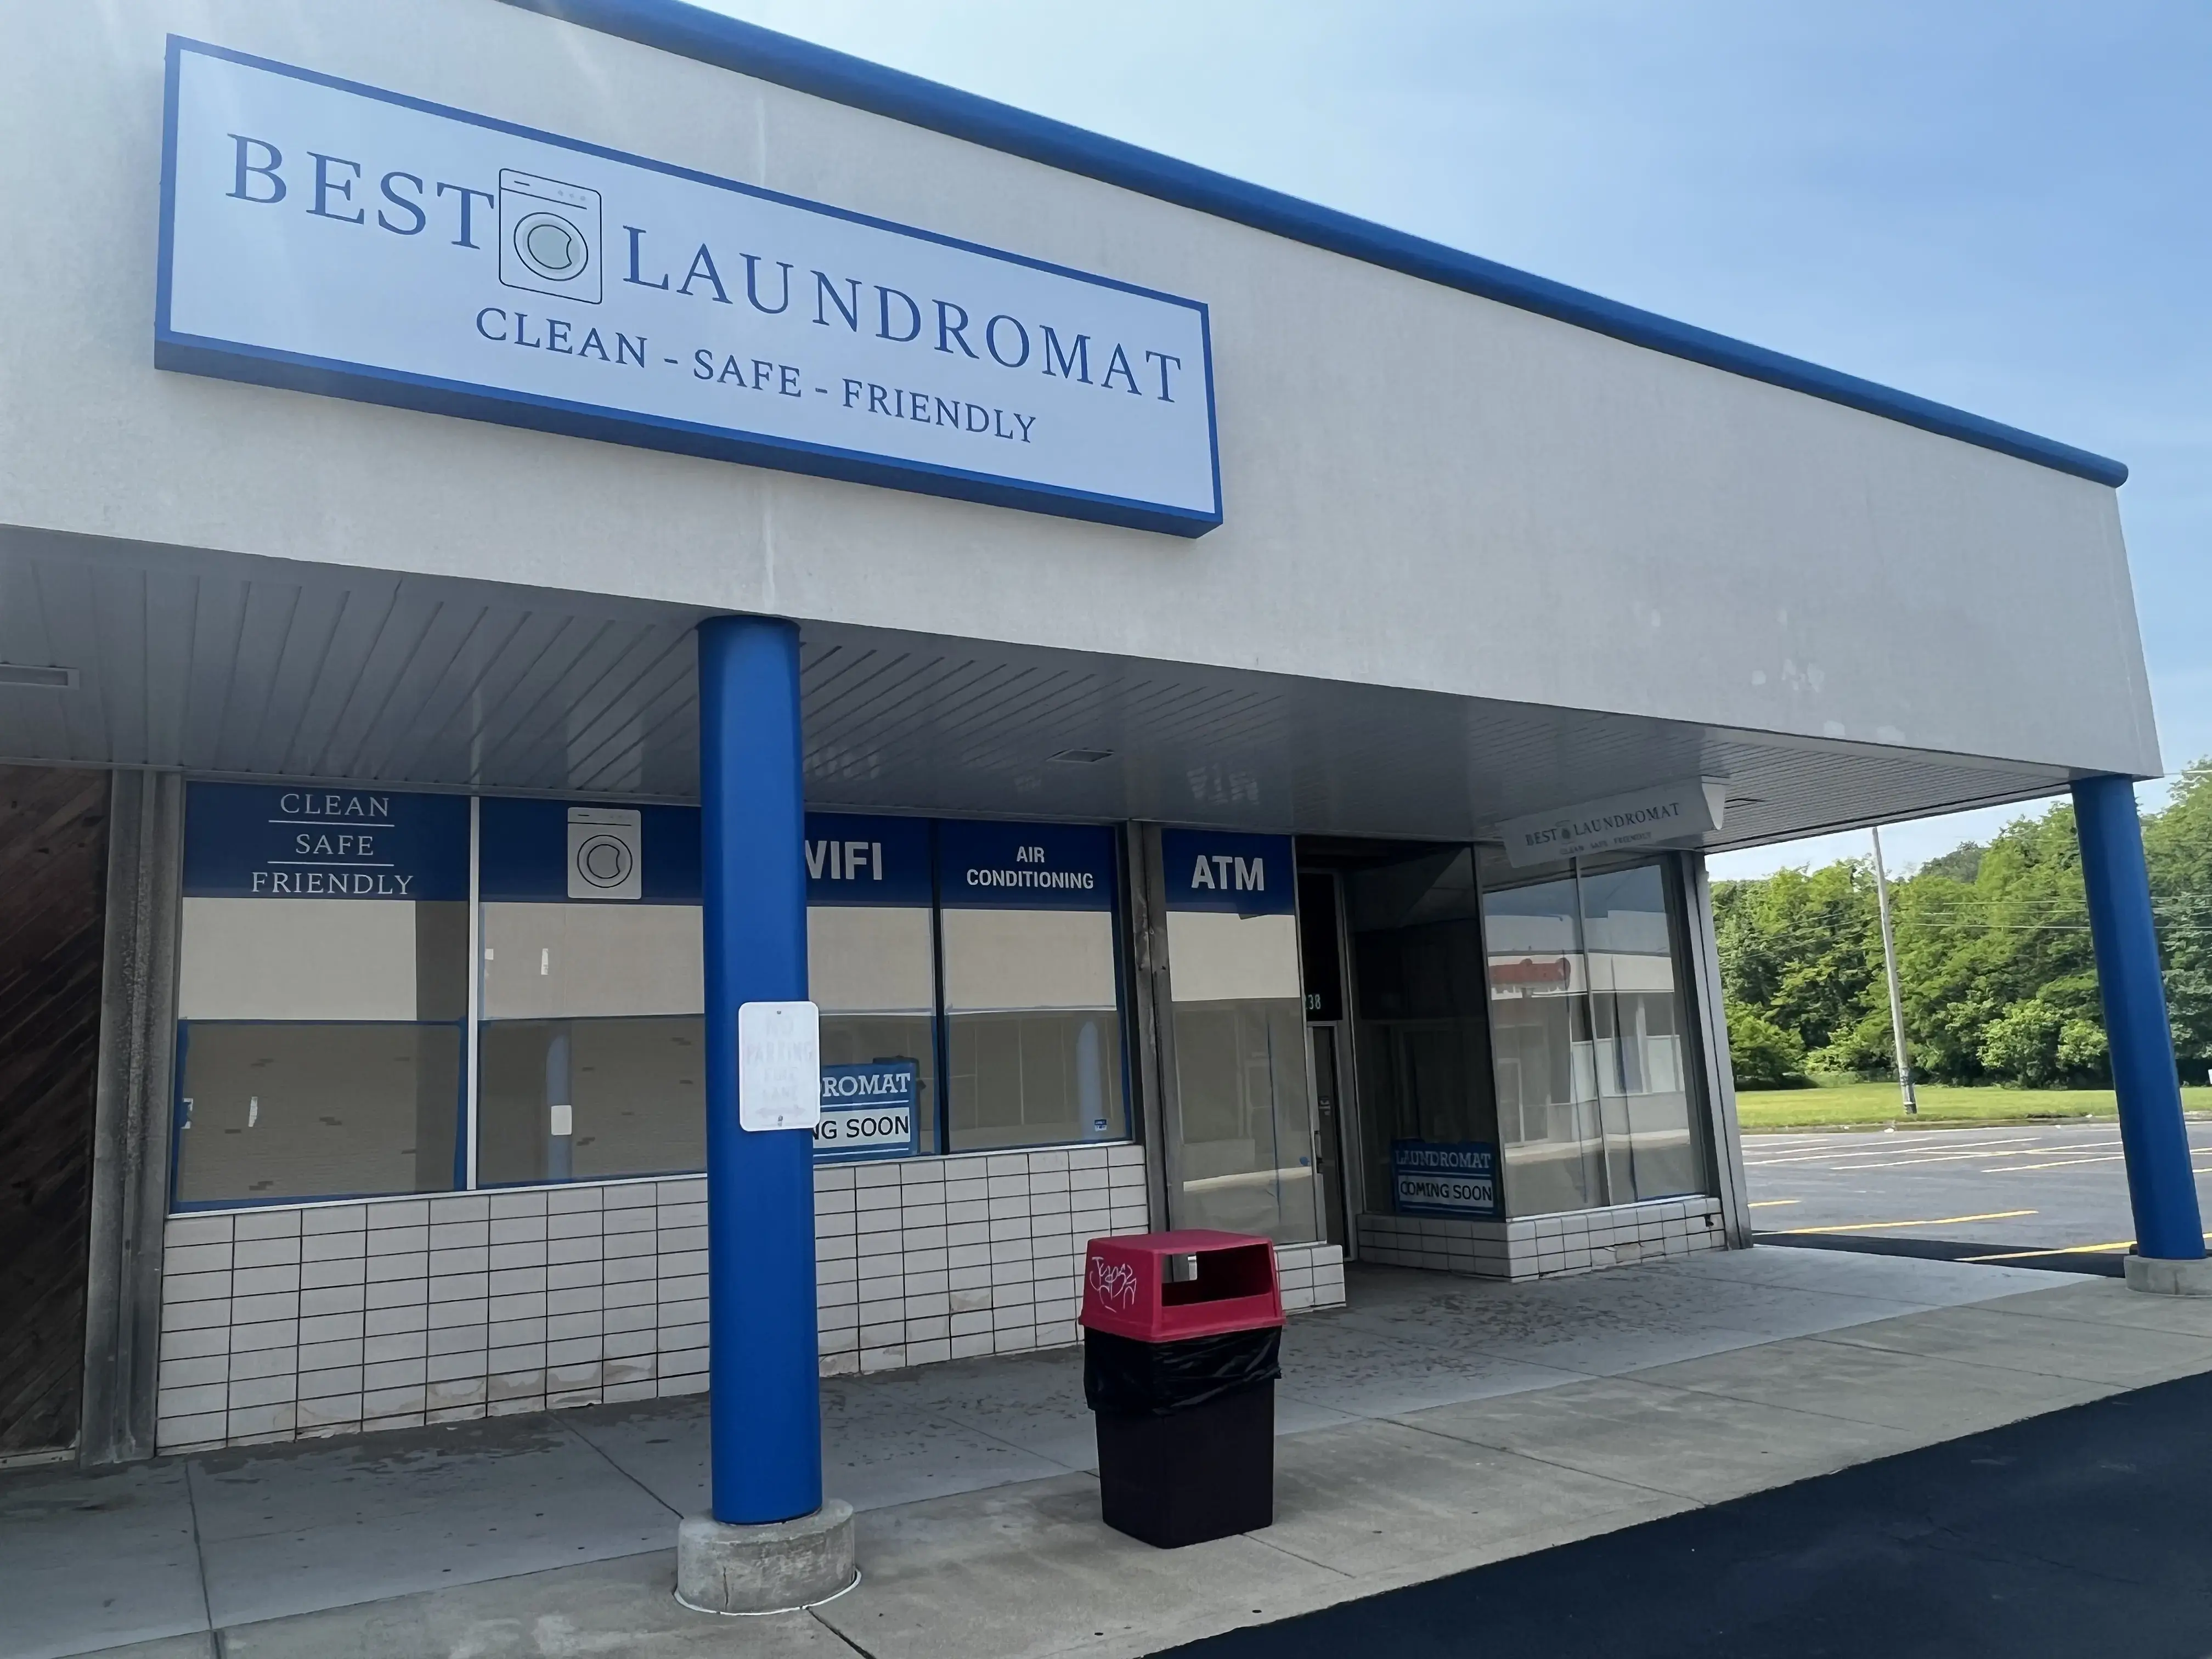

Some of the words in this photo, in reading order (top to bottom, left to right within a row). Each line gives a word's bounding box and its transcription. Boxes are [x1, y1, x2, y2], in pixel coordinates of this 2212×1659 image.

[225, 133, 494, 250] BEST
[623, 224, 1181, 403] LAUNDROMAT
[476, 307, 648, 369] CLEAN
[693, 349, 802, 398] SAFE
[842, 378, 1036, 443] FRIENDLY
[280, 793, 390, 817] CLEAN
[1525, 828, 1558, 847] BEST
[1573, 803, 1679, 836] LAUNDROMAT
[296, 833, 374, 856] SAFE
[1016, 846, 1045, 863] AIR
[251, 872, 414, 895] FRIENDLY
[966, 868, 1094, 889] CONDITIONING
[1190, 855, 1265, 891] ATM
[1304, 994, 1321, 1010] 38
[821, 1073, 911, 1097] ROMAT
[846, 1115, 909, 1138] SOON
[1395, 1150, 1491, 1169] LAUNDROMAT
[1400, 1181, 1449, 1198] COMING
[1453, 1185, 1492, 1201] SOON
